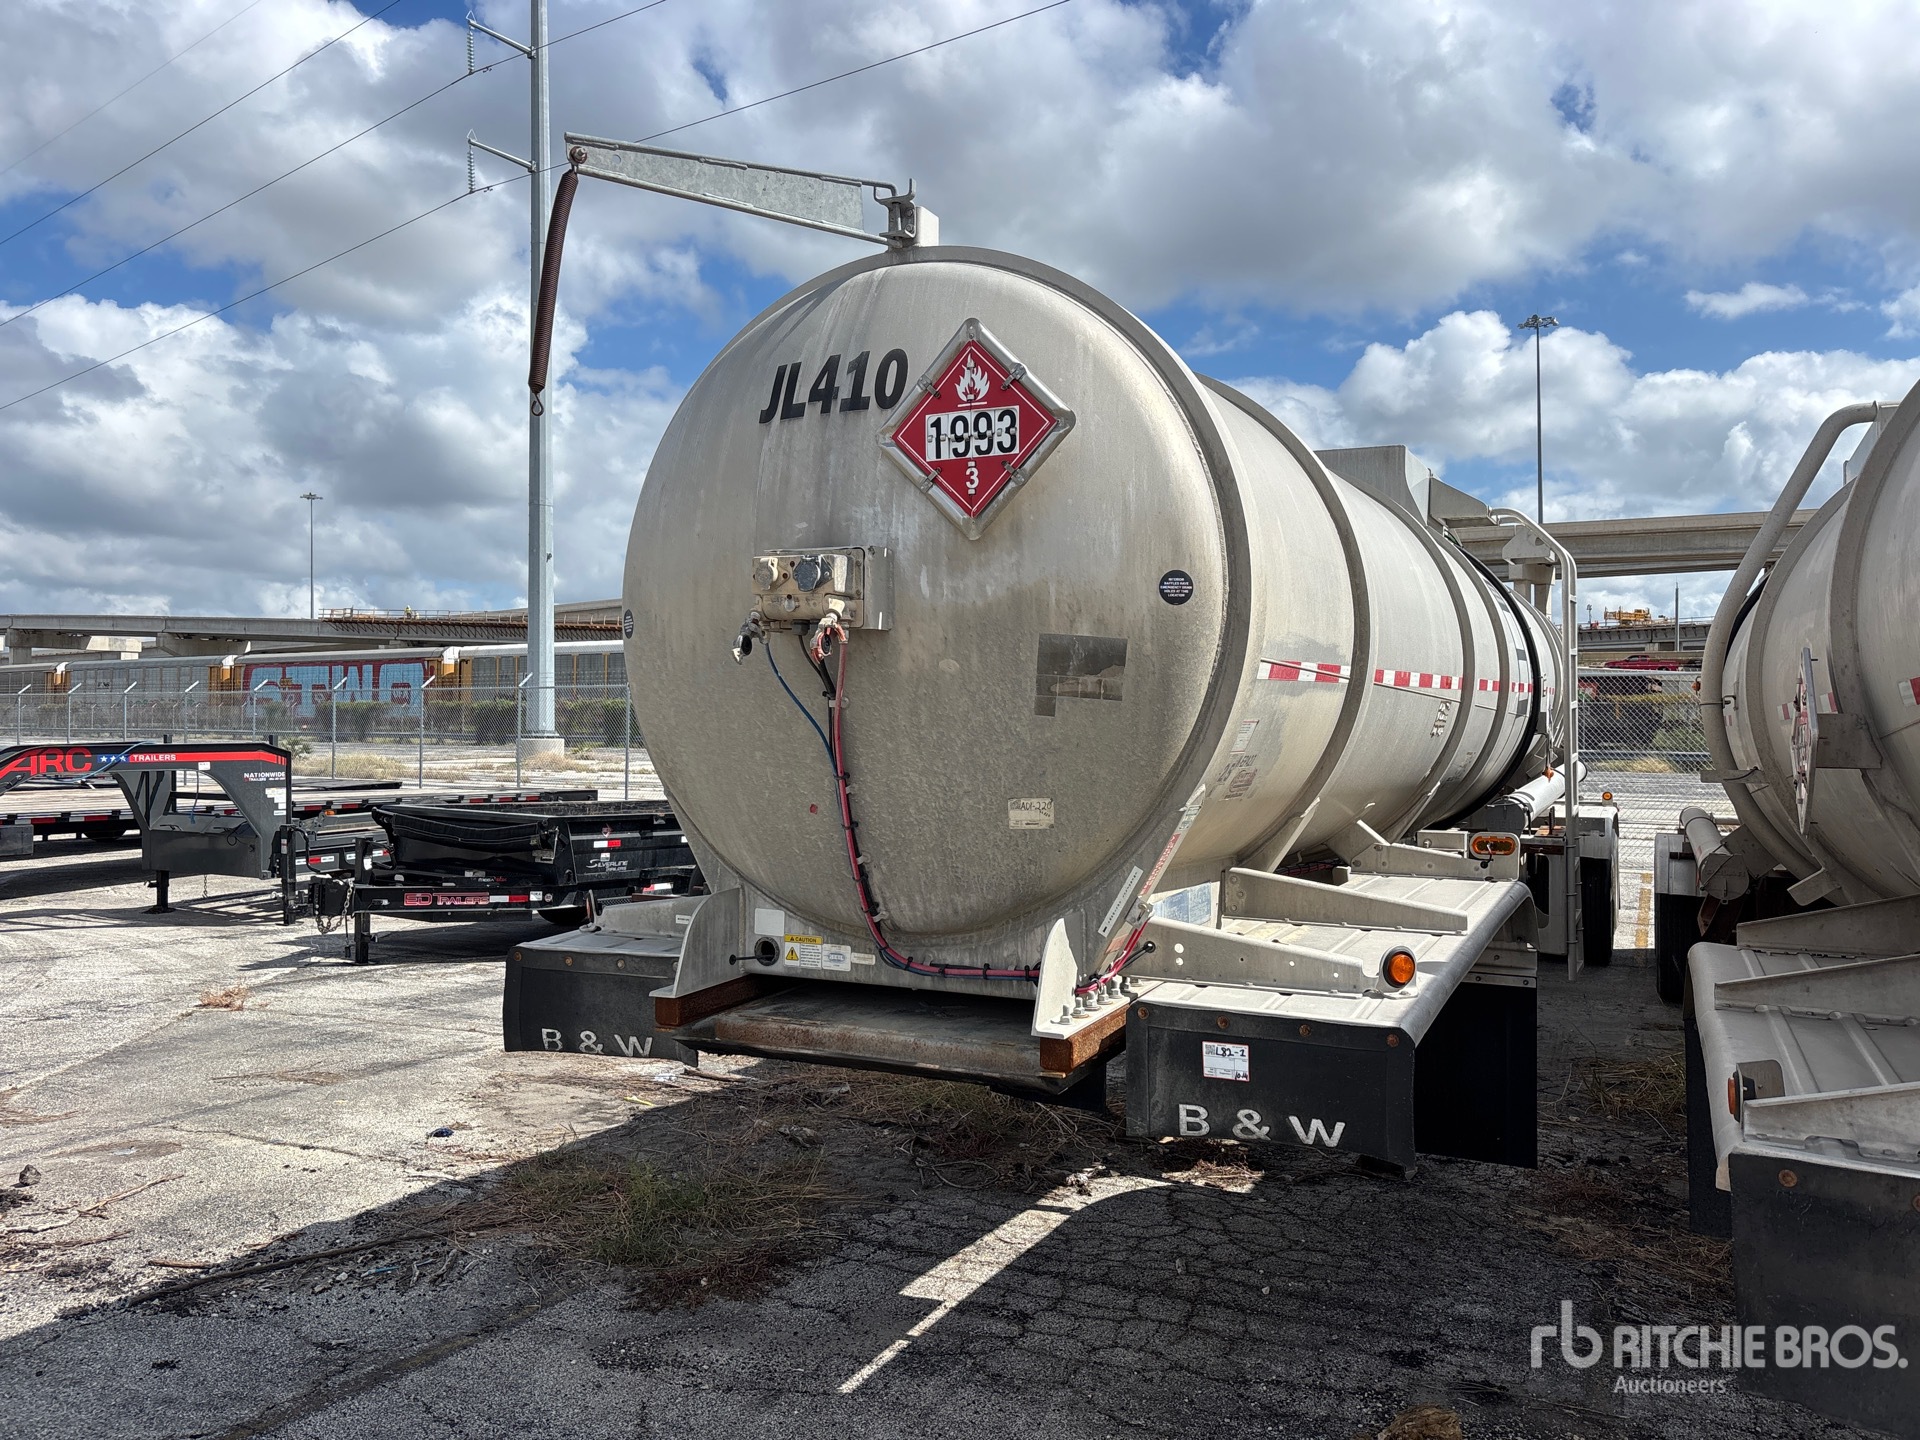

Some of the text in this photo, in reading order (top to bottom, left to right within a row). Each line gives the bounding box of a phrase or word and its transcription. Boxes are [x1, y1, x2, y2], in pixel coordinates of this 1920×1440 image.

[759, 348, 909, 424] JL410
[928, 409, 1018, 460] 1993
[965, 466, 980, 490] 3
[0, 747, 177, 779] ARC TRAILERS
[432, 891, 490, 906] TRAILERS
[795, 936, 817, 944] CAUTION
[541, 1028, 653, 1058] B & W
[1178, 1103, 1346, 1148] B & W
